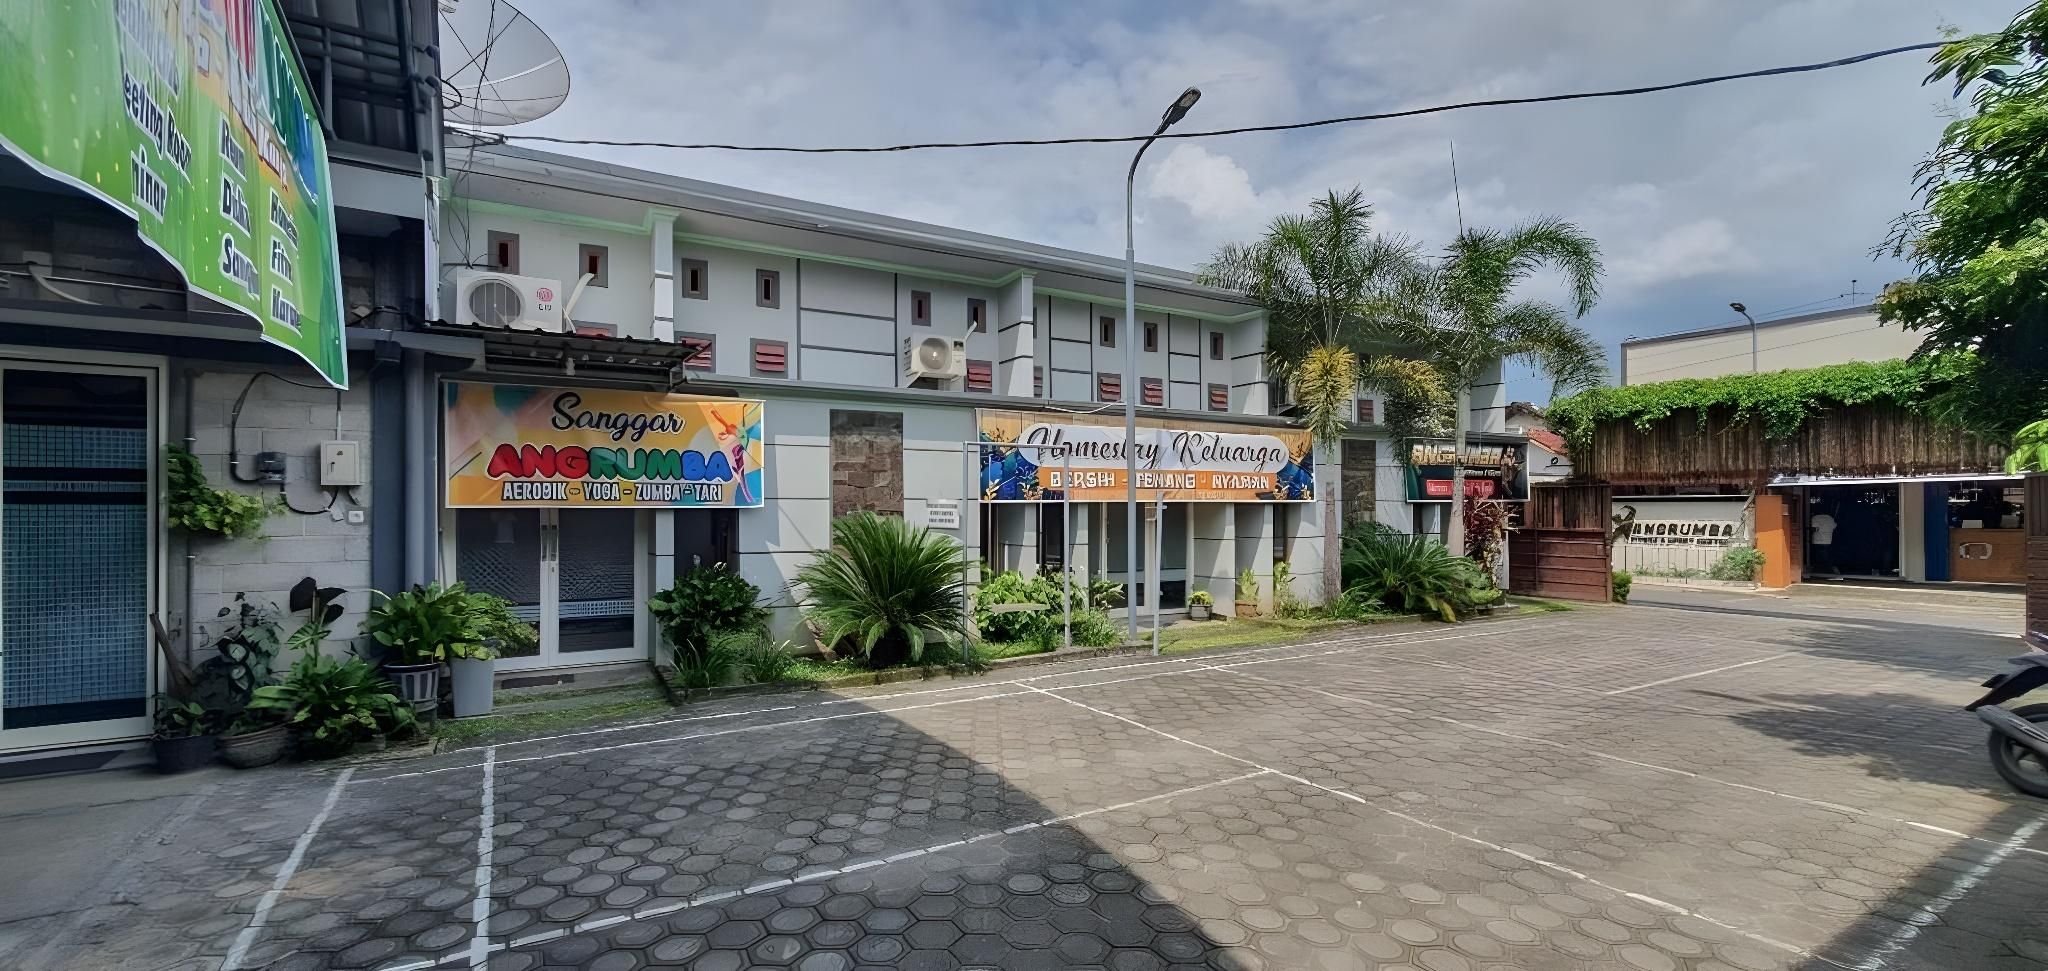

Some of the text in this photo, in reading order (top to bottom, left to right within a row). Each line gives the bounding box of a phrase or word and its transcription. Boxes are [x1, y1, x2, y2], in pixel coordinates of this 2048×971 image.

[123, 72, 164, 157] eeting
[551, 391, 684, 440] Sanggar
[487, 443, 734, 480] ANGRUMBA
[1172, 432, 1281, 472] Keluarga
[502, 481, 568, 500] AEROBIK
[582, 481, 620, 500] YOGA
[634, 483, 681, 501] ZUMBA
[694, 483, 722, 501] TARI
